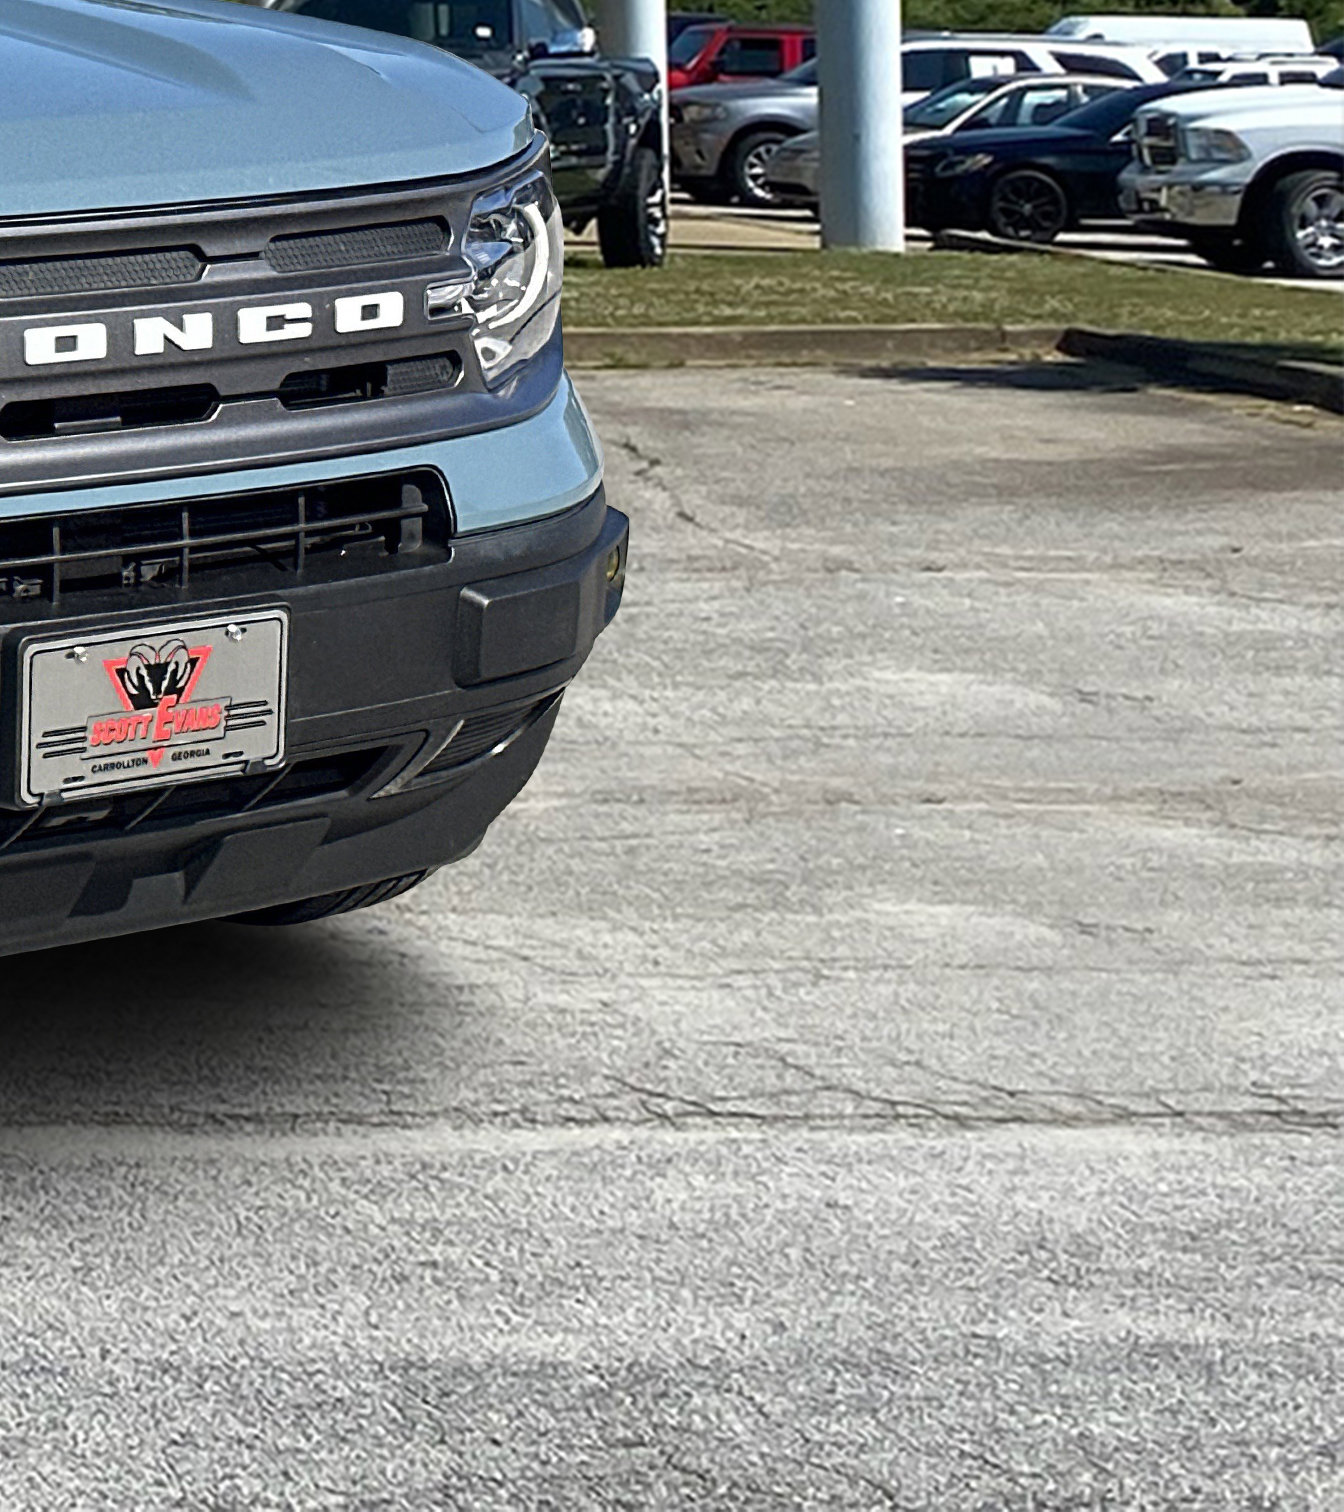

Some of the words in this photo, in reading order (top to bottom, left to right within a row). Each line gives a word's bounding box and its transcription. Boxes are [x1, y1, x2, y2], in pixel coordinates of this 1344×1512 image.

[90, 713, 153, 747] SCOTT
[91, 757, 149, 774] CARROLLTON
[171, 748, 211, 762] GEORGIA
